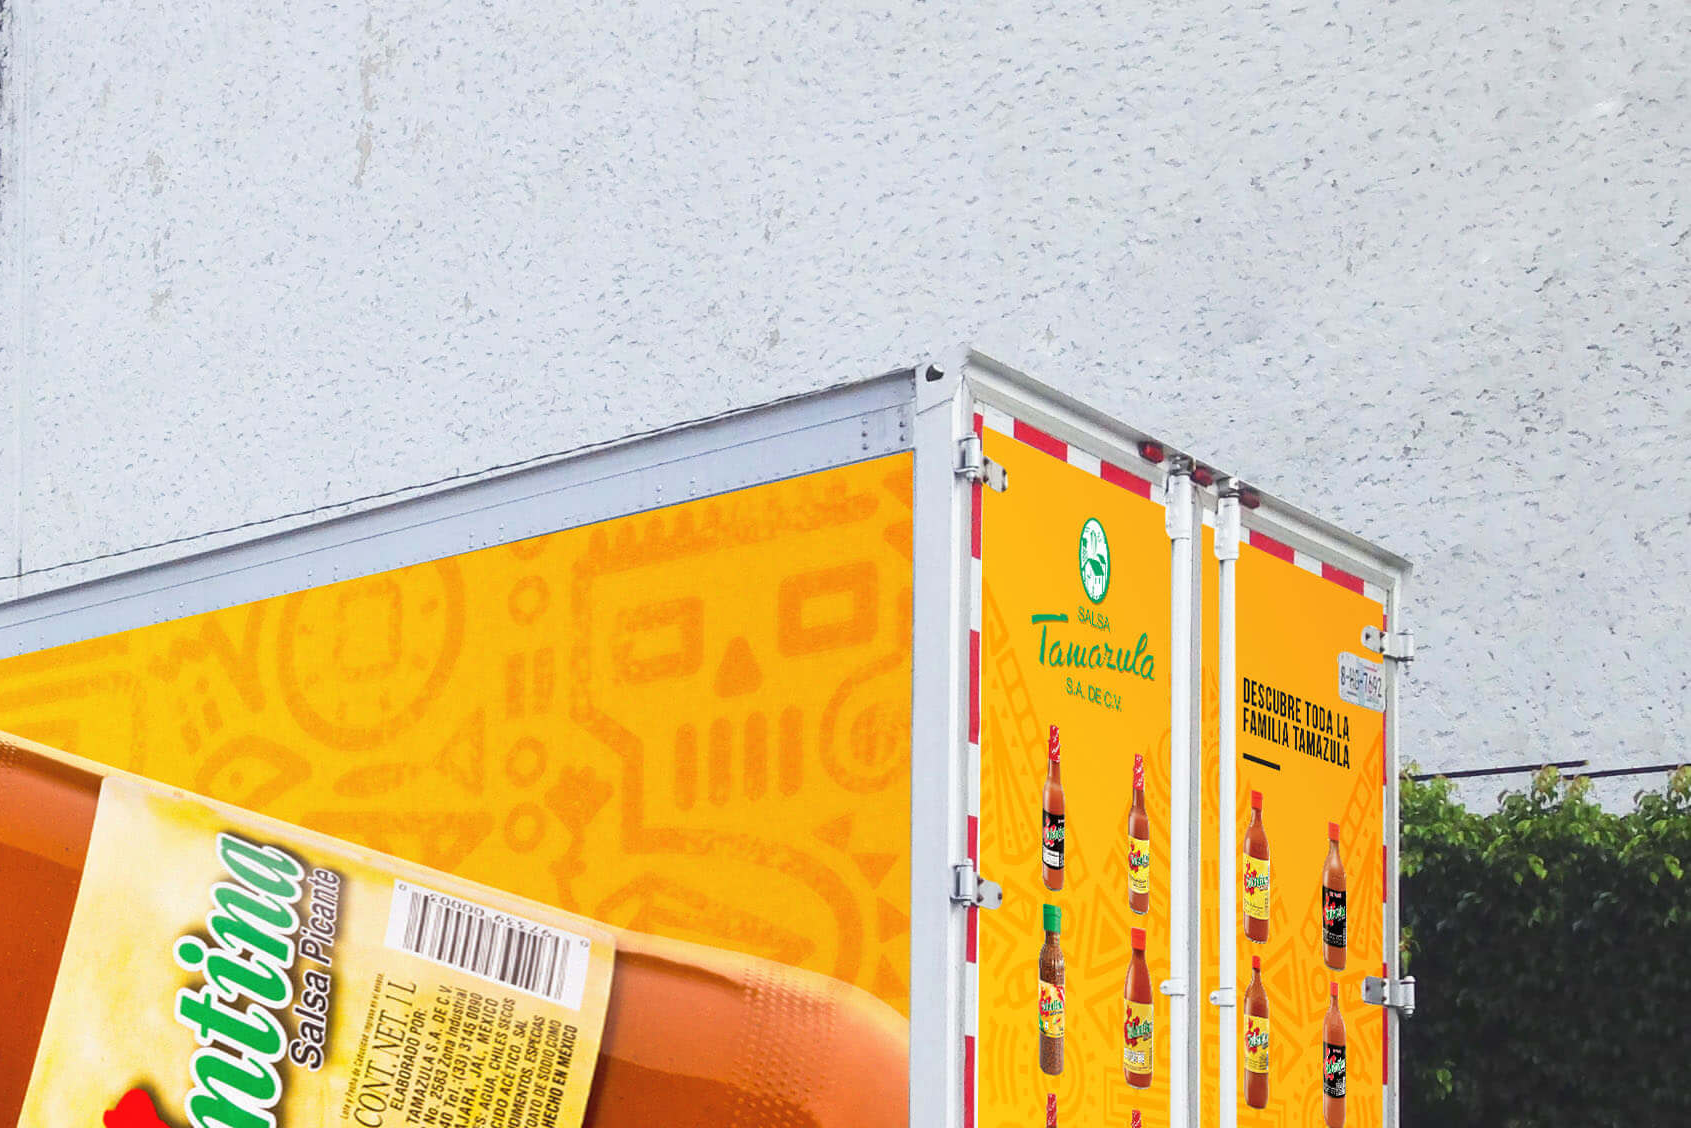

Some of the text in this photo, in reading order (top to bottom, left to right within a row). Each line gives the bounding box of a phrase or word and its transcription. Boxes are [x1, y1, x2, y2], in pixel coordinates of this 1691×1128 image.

[1078, 605, 1111, 632] SALSA
[1031, 613, 1155, 681] Tamazula
[1088, 685, 1102, 704] DE
[1243, 677, 1350, 742] DESCUBRE TODA LA
[1243, 706, 1350, 770] FAMILIA TAMAZULA
[289, 868, 340, 1072] Salsa Picante
[387, 978, 416, 994] L
[431, 1006, 447, 1023] DE
[444, 987, 468, 1037] Industrial
[497, 997, 516, 1030] SECOS
[370, 1007, 410, 1058] NET.
[424, 1027, 443, 1053] S.A.
[458, 1021, 477, 1051] 3145
[512, 1019, 527, 1038] SAL
[523, 1015, 547, 1063] ESPECIAS
[544, 1019, 562, 1048] COMO
[389, 1007, 427, 1111] ELABORADO POR:
[438, 1039, 456, 1068] Zona
[487, 1031, 508, 1070] CHILES
[553, 1024, 578, 1068] MÉXICO
[536, 1049, 555, 1081] SODIO
[553, 1069, 567, 1085] EN
[352, 1058, 397, 1128] CONT.
[405, 1055, 436, 1124] TAMAZULA
[429, 1069, 448, 1099] 2583
[532, 1082, 547, 1097] DE
[423, 1103, 439, 1125] No.
[541, 1087, 564, 1128] HECHO
